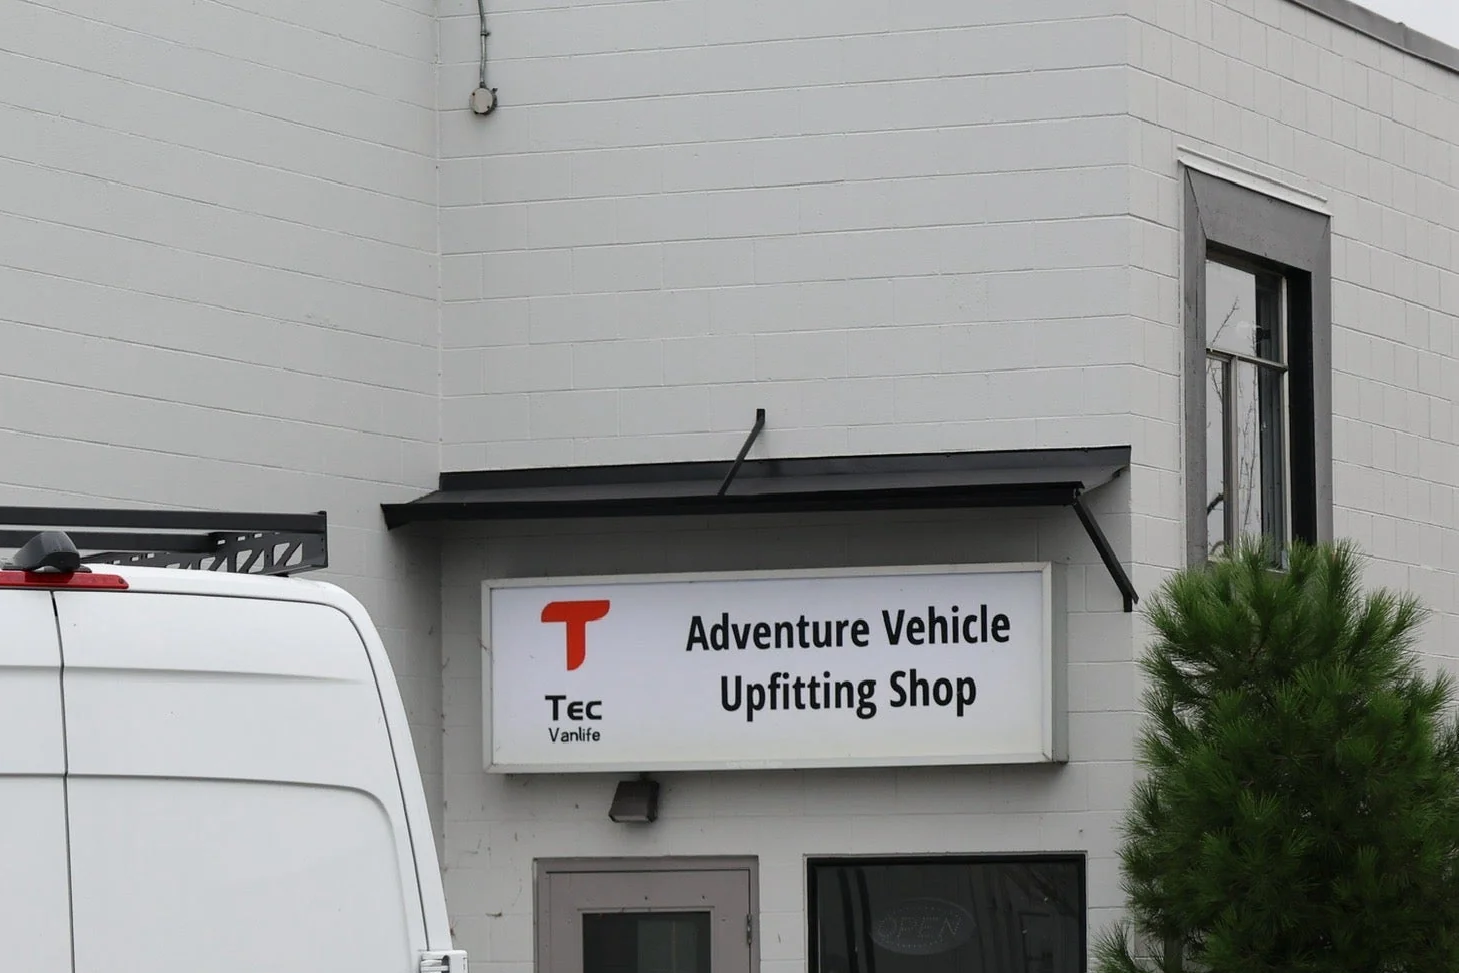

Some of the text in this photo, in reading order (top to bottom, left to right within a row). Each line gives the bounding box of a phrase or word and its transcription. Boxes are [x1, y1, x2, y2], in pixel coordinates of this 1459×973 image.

[685, 603, 1011, 652] Adventure Vehicle
[720, 668, 977, 723] Upfitting Shop
[548, 726, 601, 744] Vanlife
[878, 914, 962, 940] OPEN
